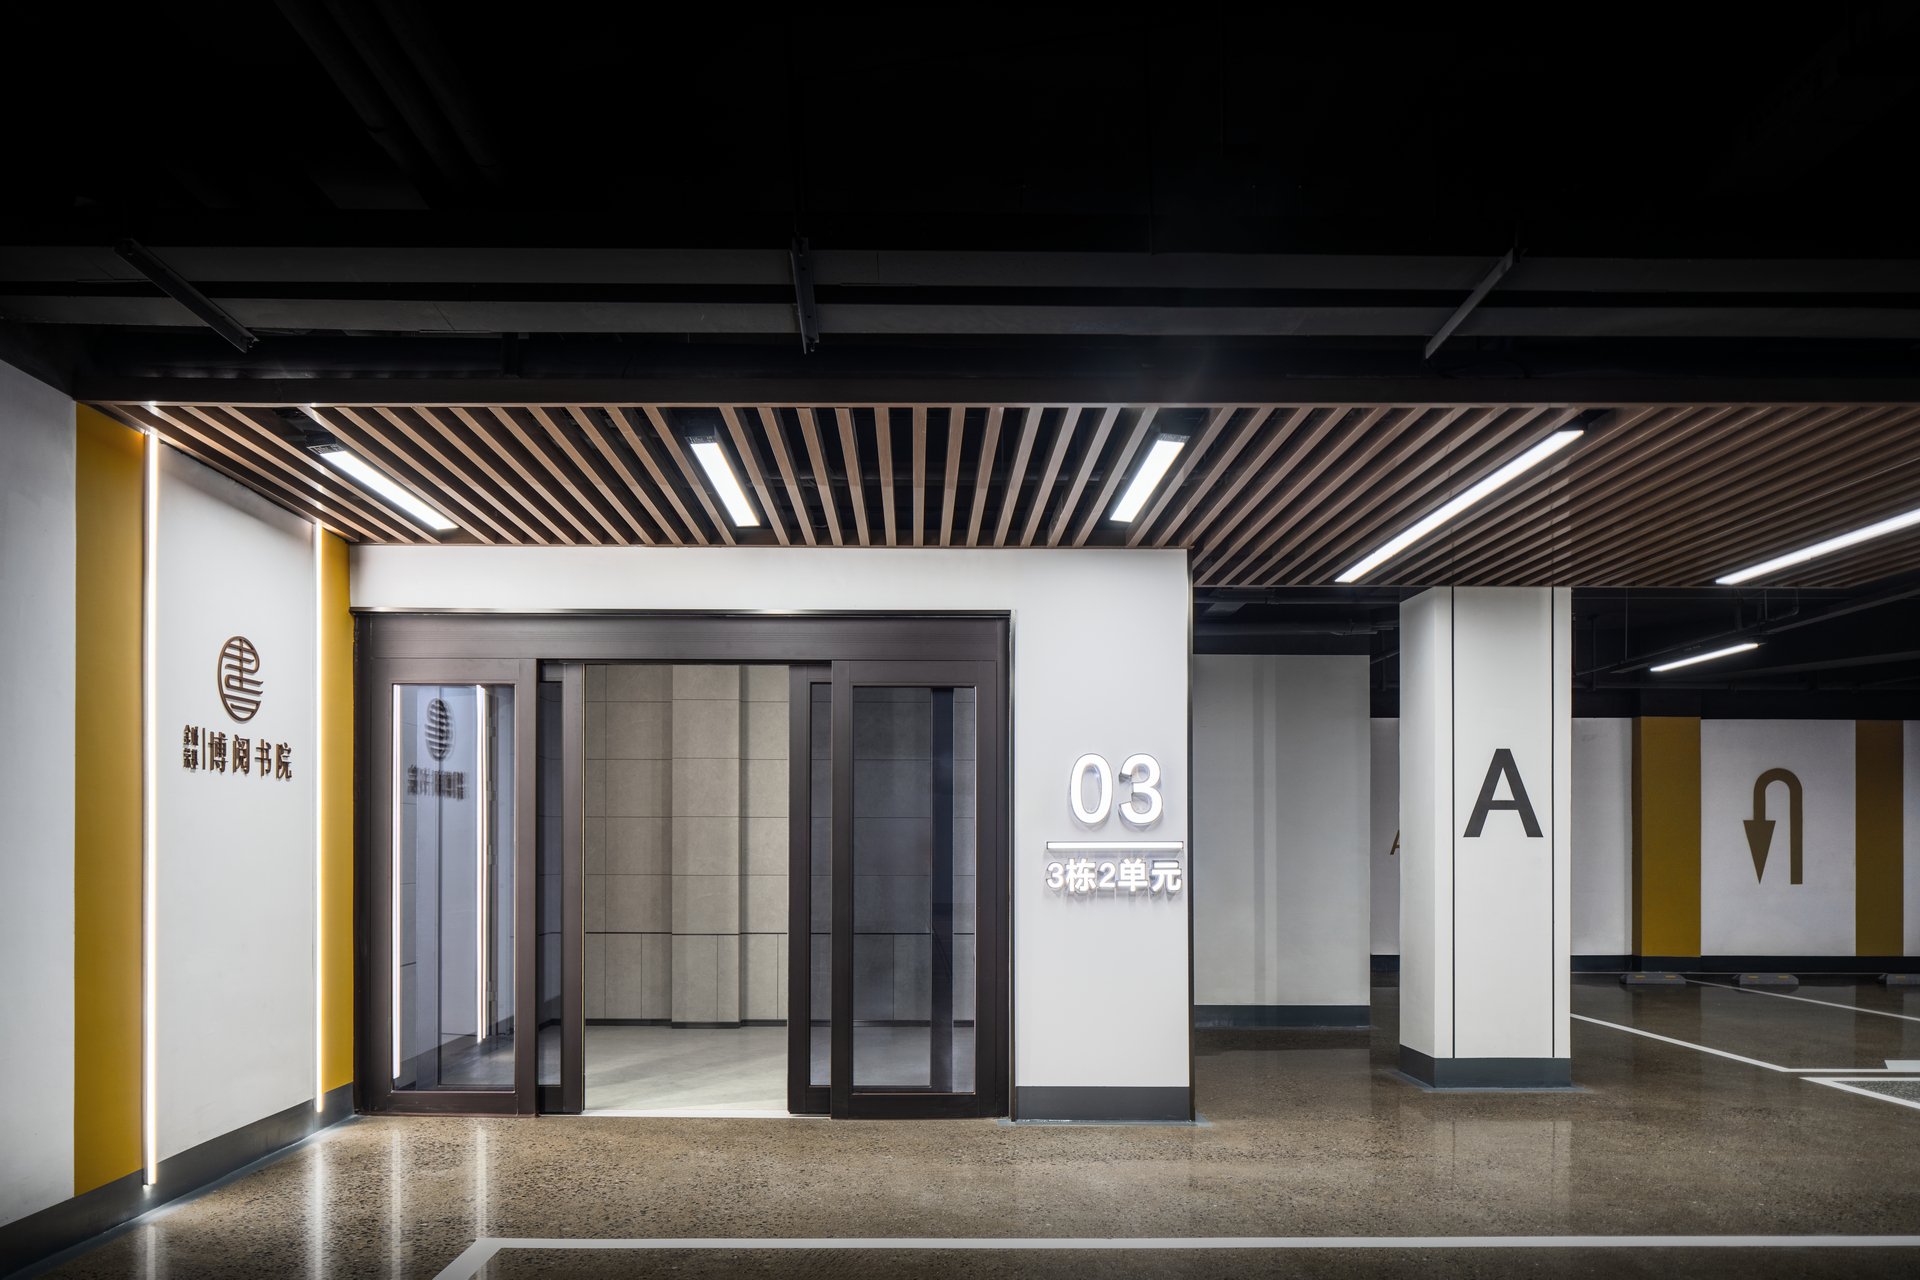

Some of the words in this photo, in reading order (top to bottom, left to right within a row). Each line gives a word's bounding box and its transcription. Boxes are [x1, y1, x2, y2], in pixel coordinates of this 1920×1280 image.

[208, 731, 292, 780] 博阅书院
[1070, 752, 1164, 825] 03
[1463, 748, 1544, 838] A
[1046, 858, 1183, 893] 3栋2单元
